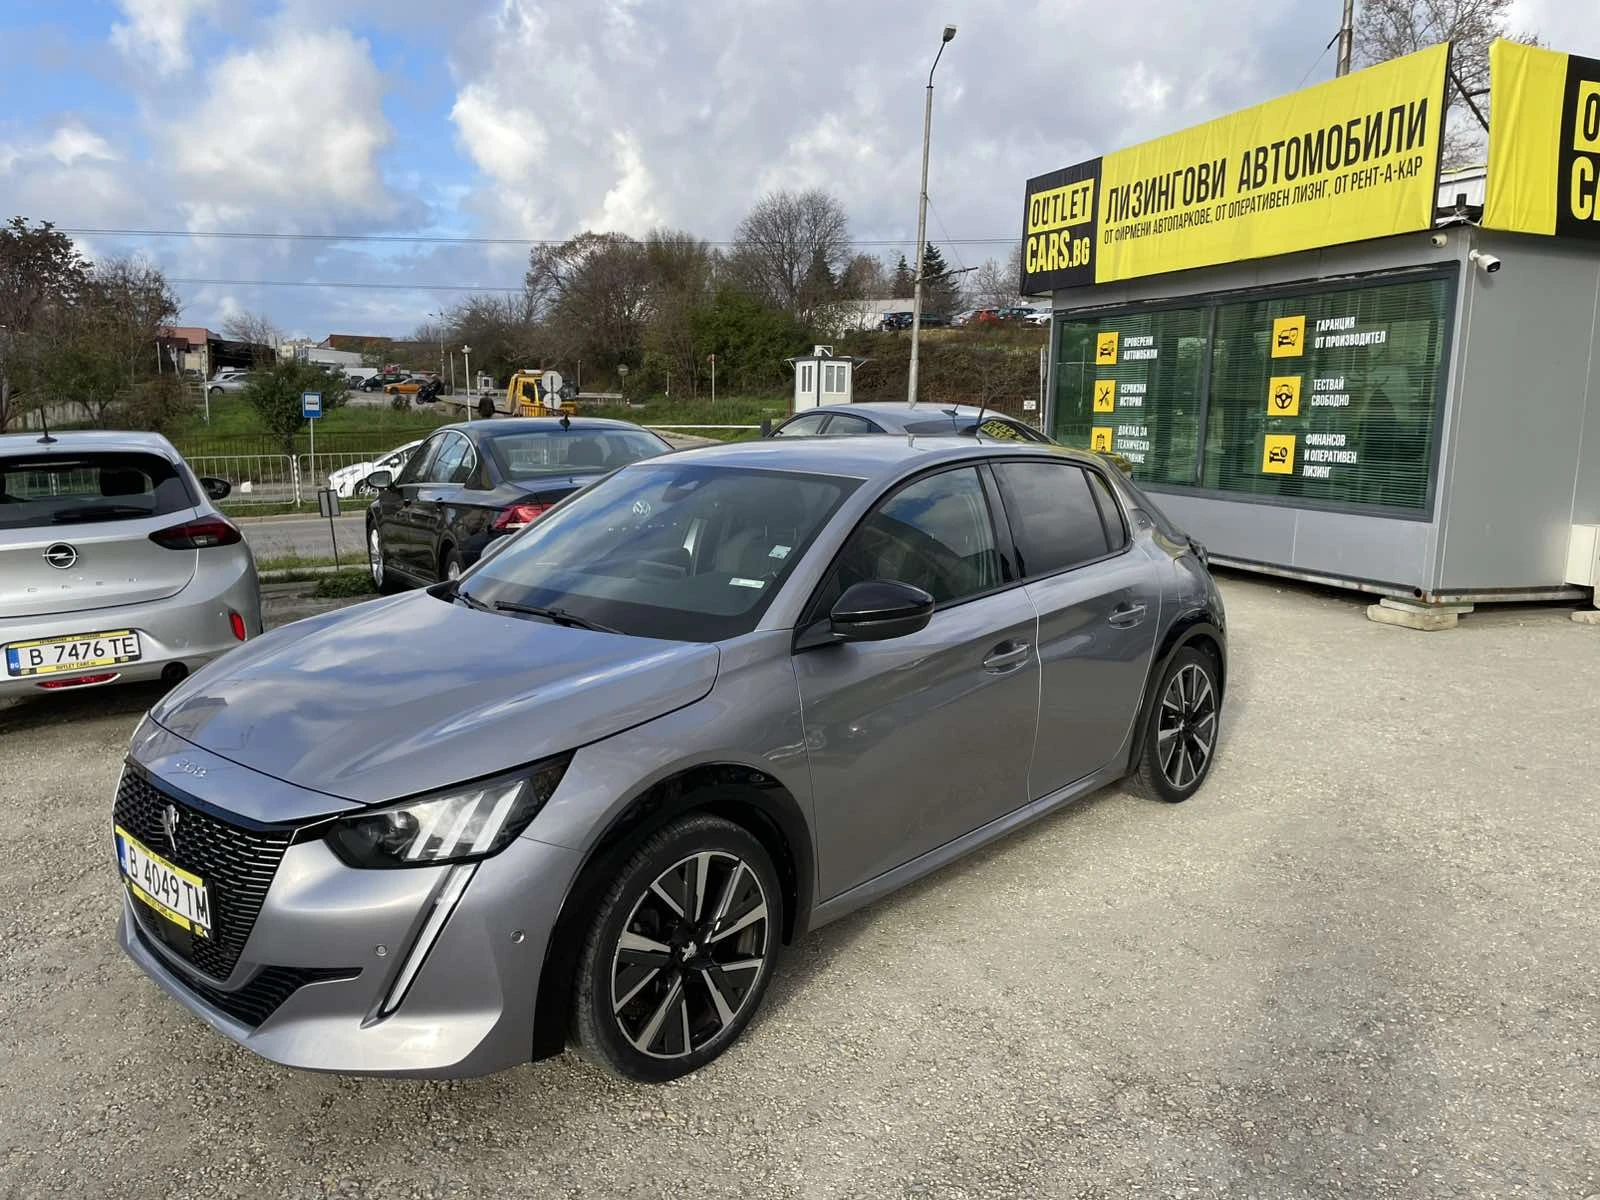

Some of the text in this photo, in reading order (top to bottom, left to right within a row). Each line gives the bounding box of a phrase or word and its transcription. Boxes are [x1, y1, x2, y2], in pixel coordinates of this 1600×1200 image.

[1105, 97, 1428, 224] ЛИЗИНГОВИ АВТОМОБИЛИ
[1032, 186, 1090, 228] OUTLET
[1104, 229, 1114, 245] ОТ
[1115, 223, 1151, 241] ФИРМЕНИ
[1215, 203, 1227, 222] ОТ
[1228, 188, 1290, 219] ОПЕРАТИВЕН
[1334, 174, 1349, 195] ОТ
[1350, 156, 1423, 192] РЕНТ-А-КАР
[1026, 230, 1091, 274] CARS.BG
[1316, 316, 1355, 332] ГАРАНЦИЯ
[1314, 331, 1386, 349] ОТ ПРОИЗВОДИТЕЛ
[1313, 376, 1345, 391] ТЕСТВАЙ
[1311, 394, 1350, 408] СВОБОДНО
[1305, 433, 1346, 447] ФИНАНСОВ
[1303, 449, 1357, 465] И ОПЕРАТИВЕН
[1302, 465, 1332, 478] ЛИЗИНГ
[29, 648, 44, 666] B
[54, 641, 105, 663] 7476
[109, 637, 137, 655] TE
[129, 845, 138, 878] B
[144, 858, 180, 908] 4049
[182, 880, 209, 925] TM
